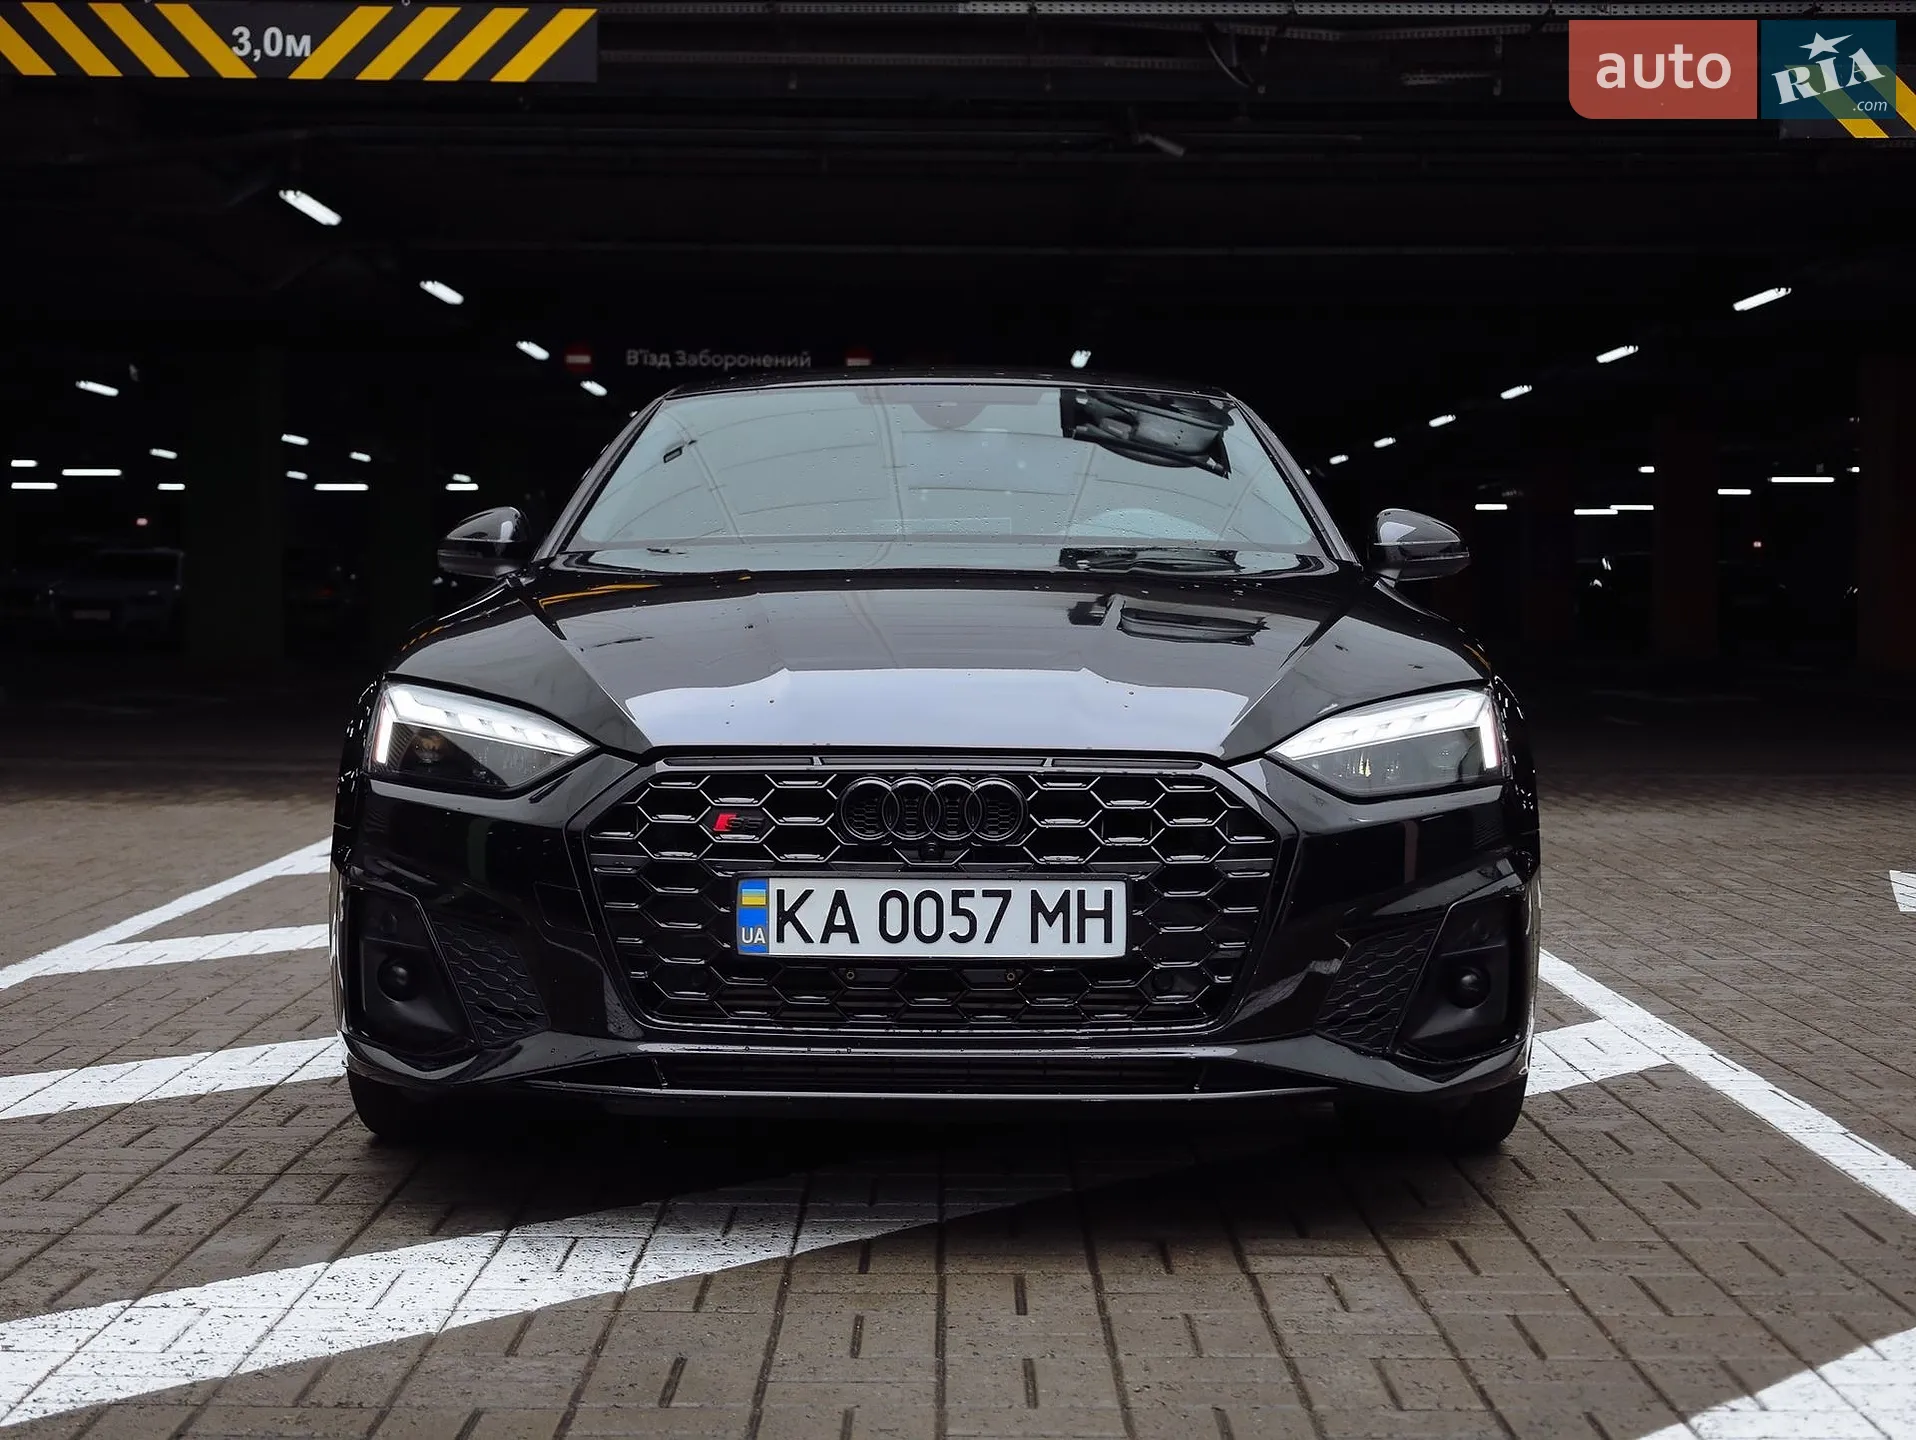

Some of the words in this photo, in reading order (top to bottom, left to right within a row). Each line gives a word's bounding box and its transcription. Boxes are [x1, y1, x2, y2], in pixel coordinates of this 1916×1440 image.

[231, 26, 312, 61] 3,0м
[675, 349, 811, 371] Заборонений
[776, 889, 860, 944] KA
[878, 889, 1012, 944] 0057
[1030, 889, 1113, 944] MH
[741, 927, 766, 944] UA
